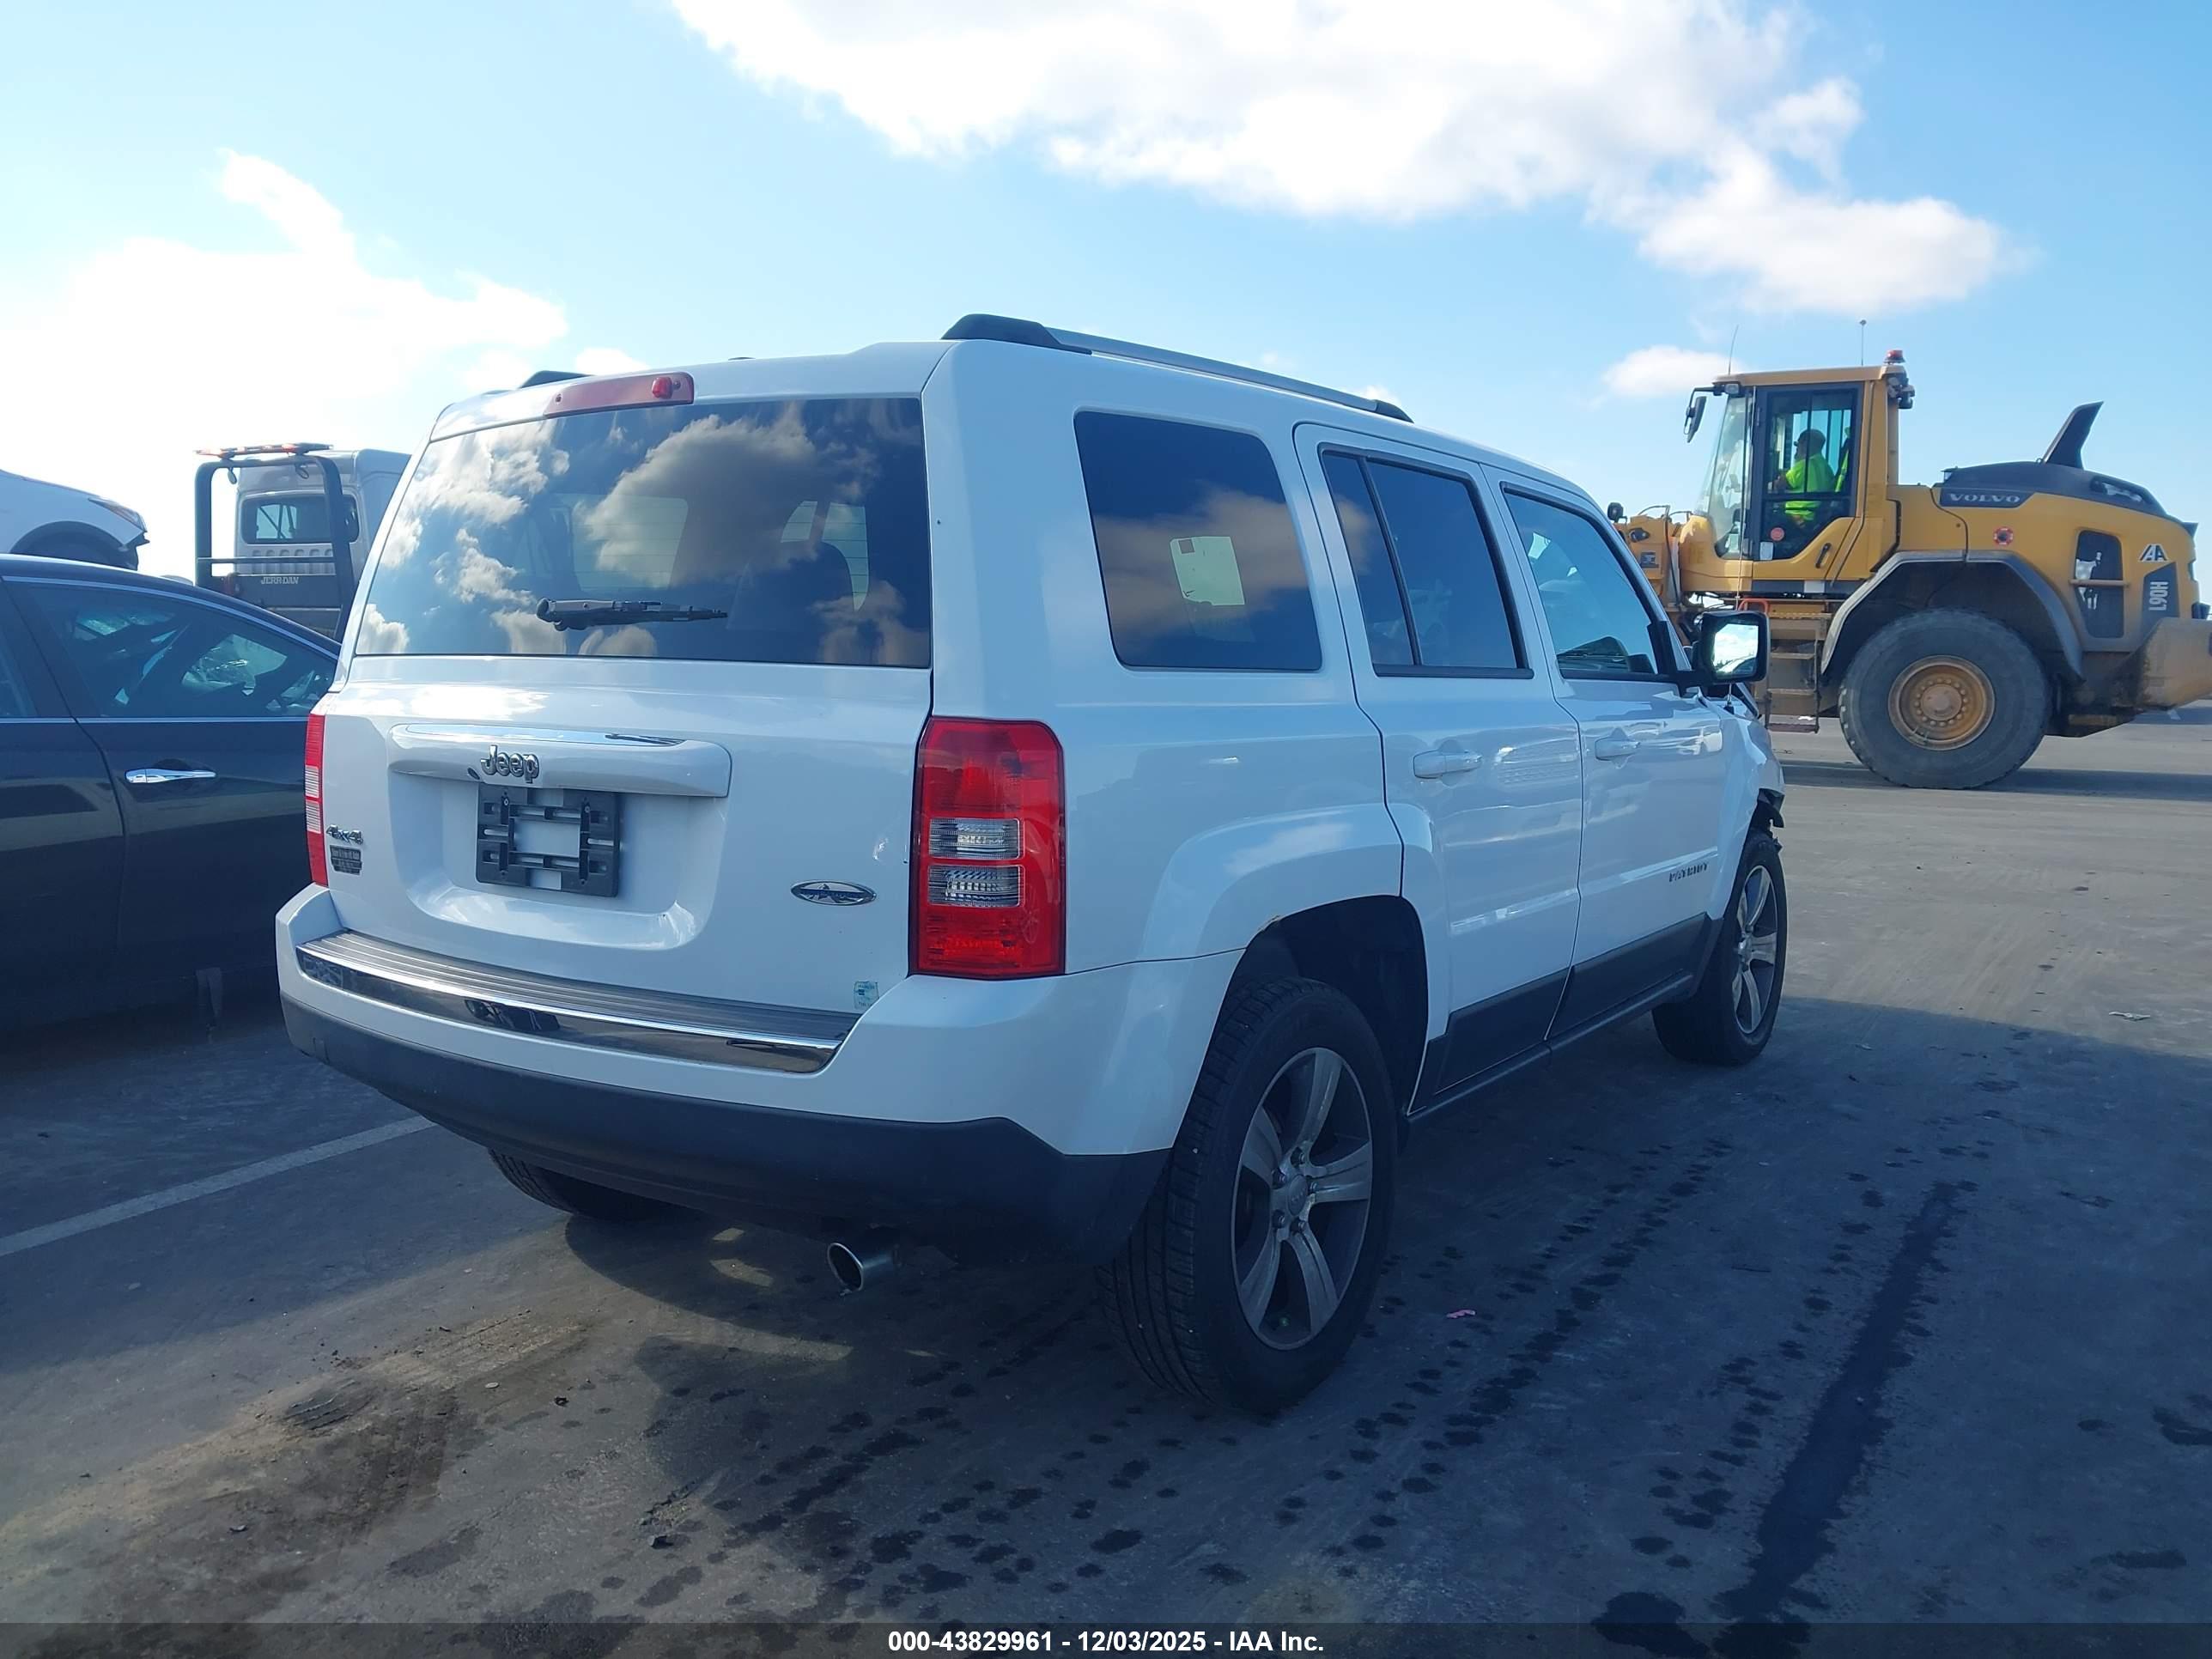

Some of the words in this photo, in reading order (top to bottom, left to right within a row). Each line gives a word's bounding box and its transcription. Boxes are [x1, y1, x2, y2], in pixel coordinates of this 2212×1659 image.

[1949, 493, 2021, 503] VOLVO
[2148, 580, 2169, 611] L90H
[480, 744, 540, 784] Jeep
